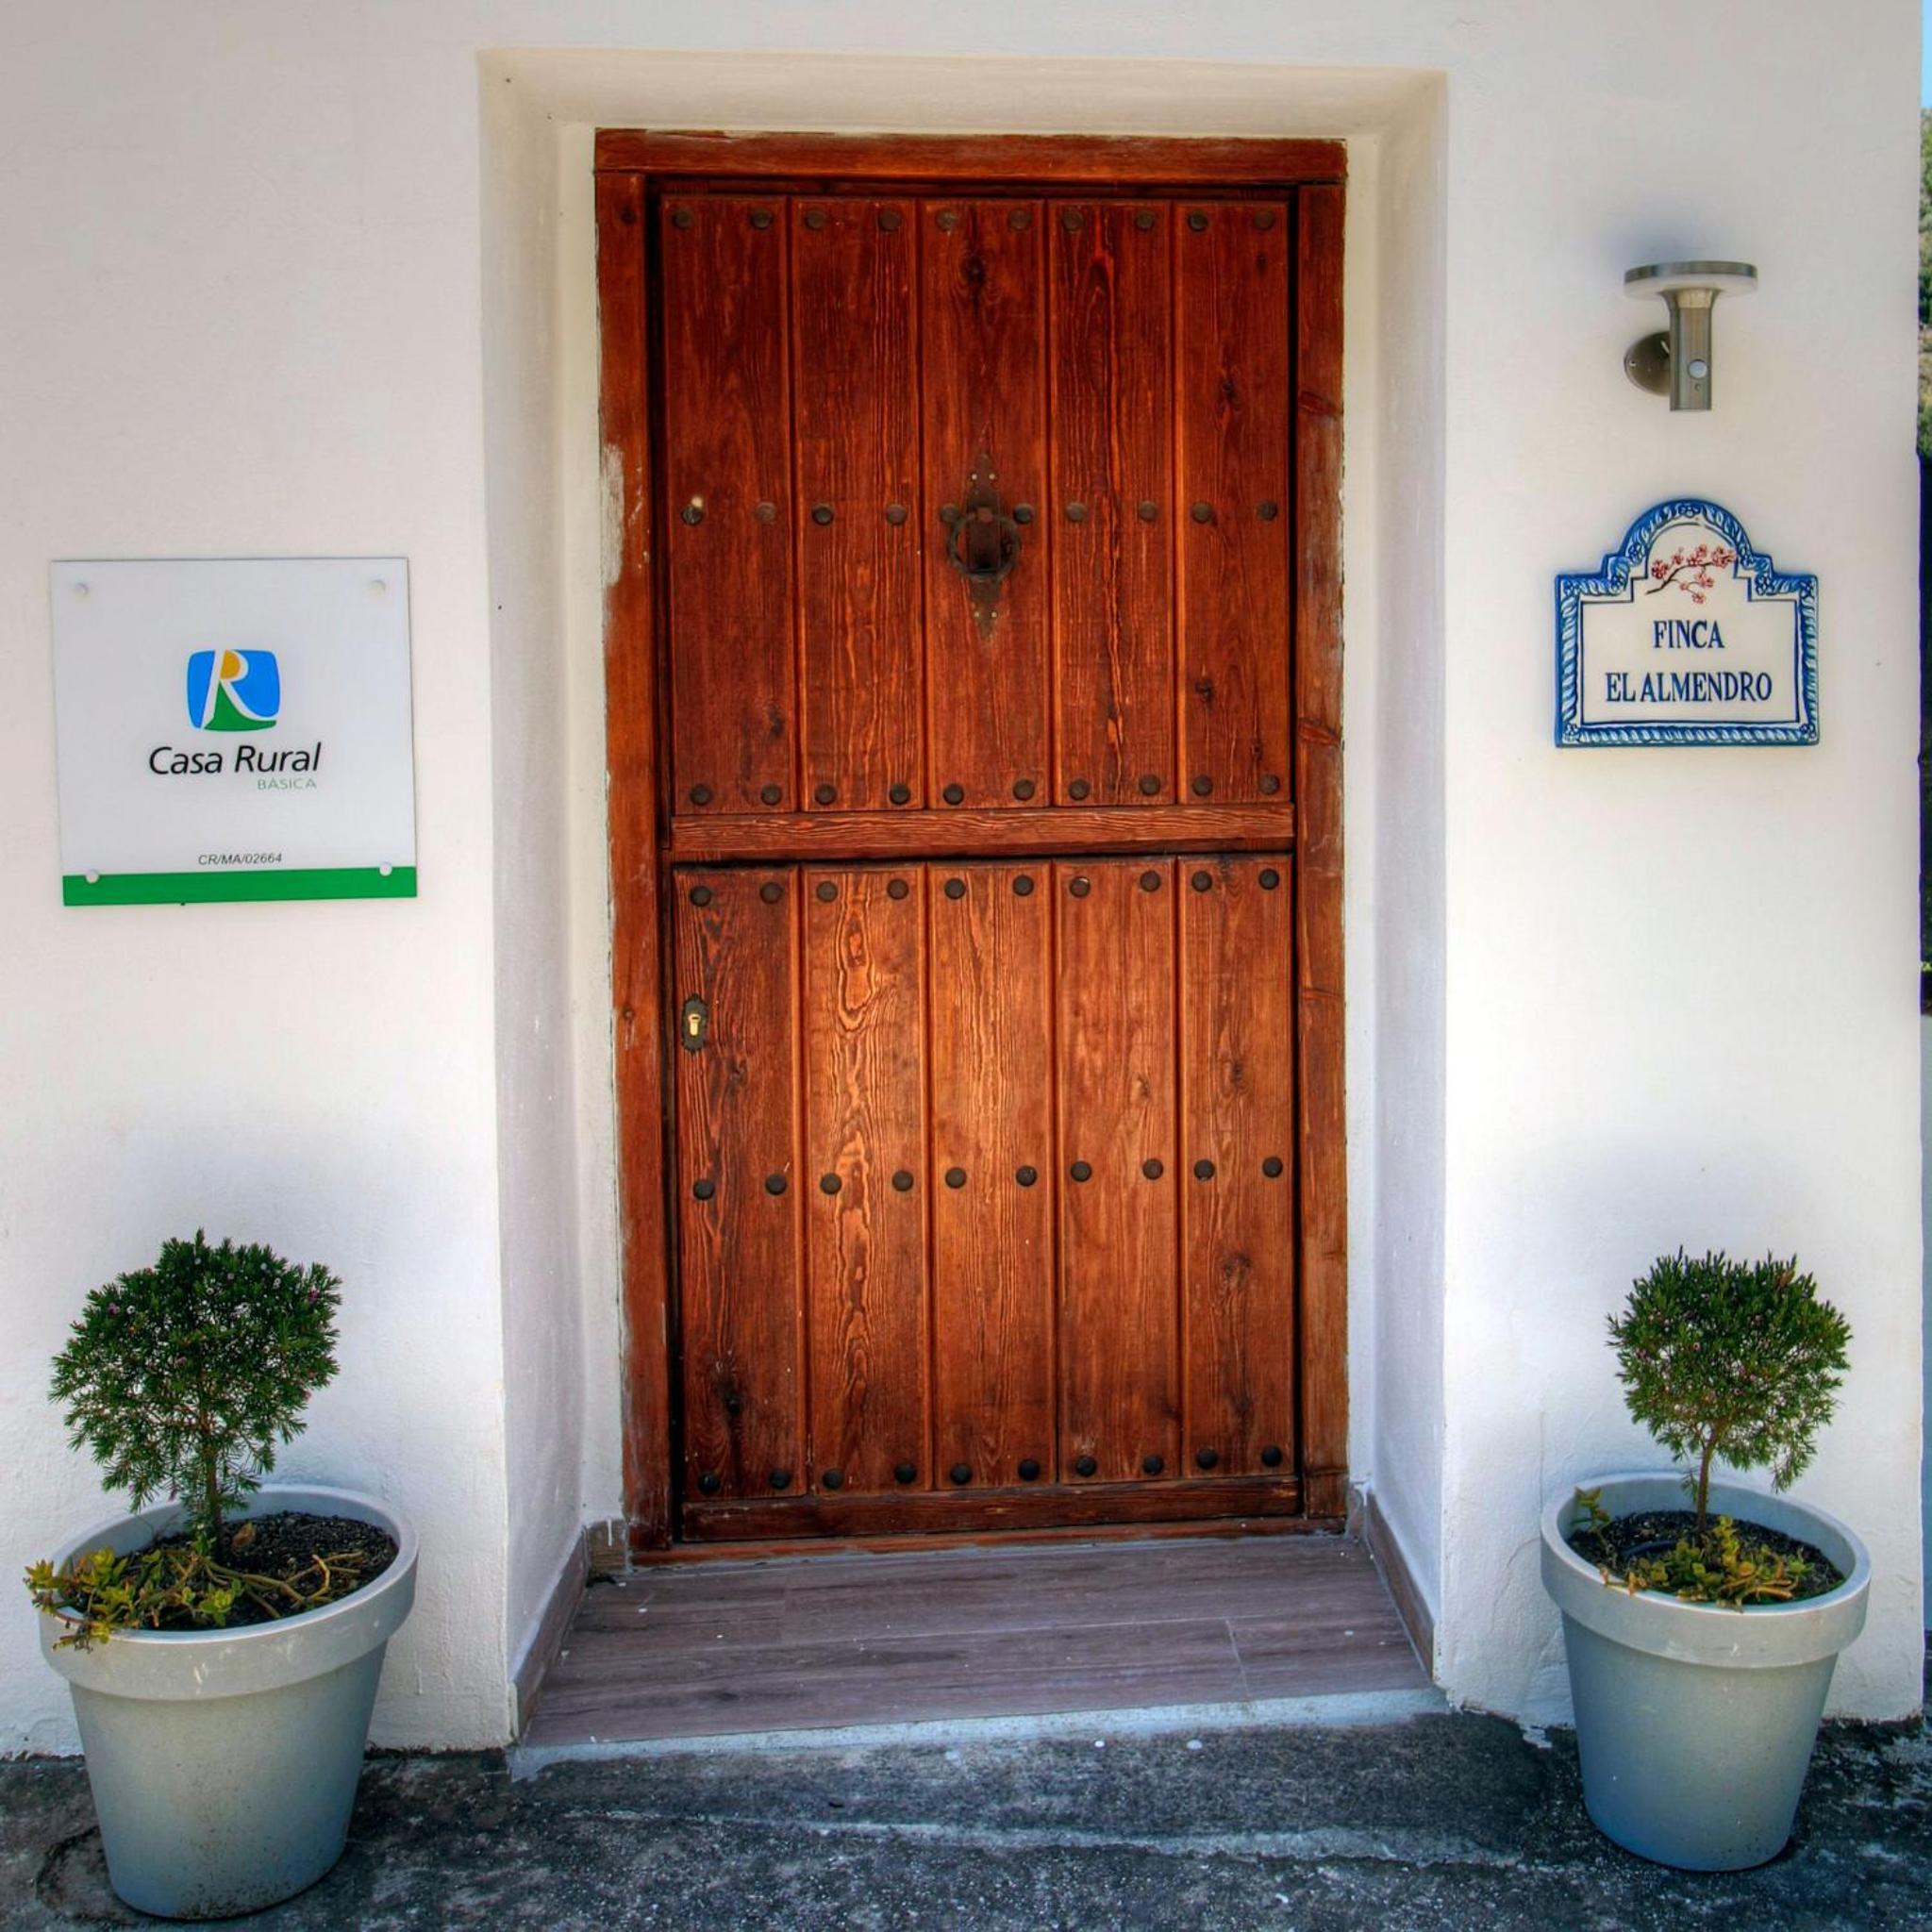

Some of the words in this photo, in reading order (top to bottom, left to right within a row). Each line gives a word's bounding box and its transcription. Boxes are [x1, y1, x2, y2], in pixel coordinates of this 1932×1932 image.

[1653, 620, 1725, 649] FINCA
[1605, 672, 1636, 703] EL
[1640, 672, 1773, 703] ALMENDRO
[148, 746, 223, 774] Casa
[234, 741, 322, 773] Rural
[197, 852, 282, 865] CR/MA/02664
